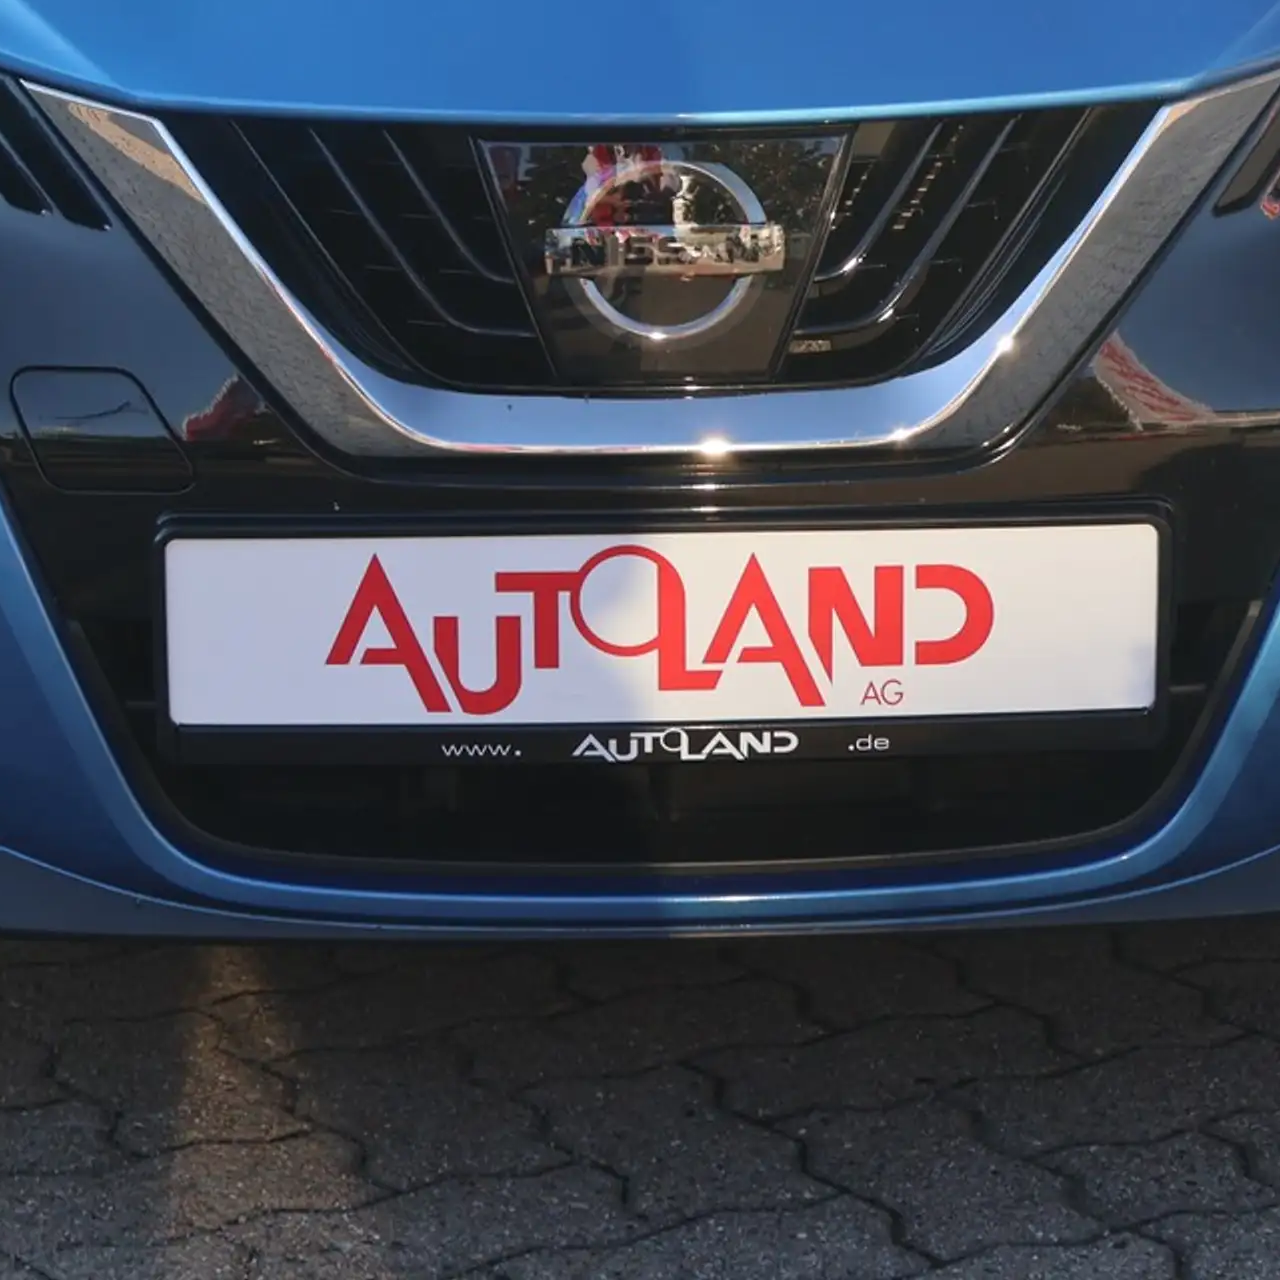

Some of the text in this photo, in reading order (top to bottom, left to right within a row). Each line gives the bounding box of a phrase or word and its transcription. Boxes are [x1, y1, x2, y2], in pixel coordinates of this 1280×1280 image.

[323, 543, 995, 716] AUTOLAND
[860, 679, 905, 707] AG
[440, 726, 891, 763] www. AUTOLAND .de
